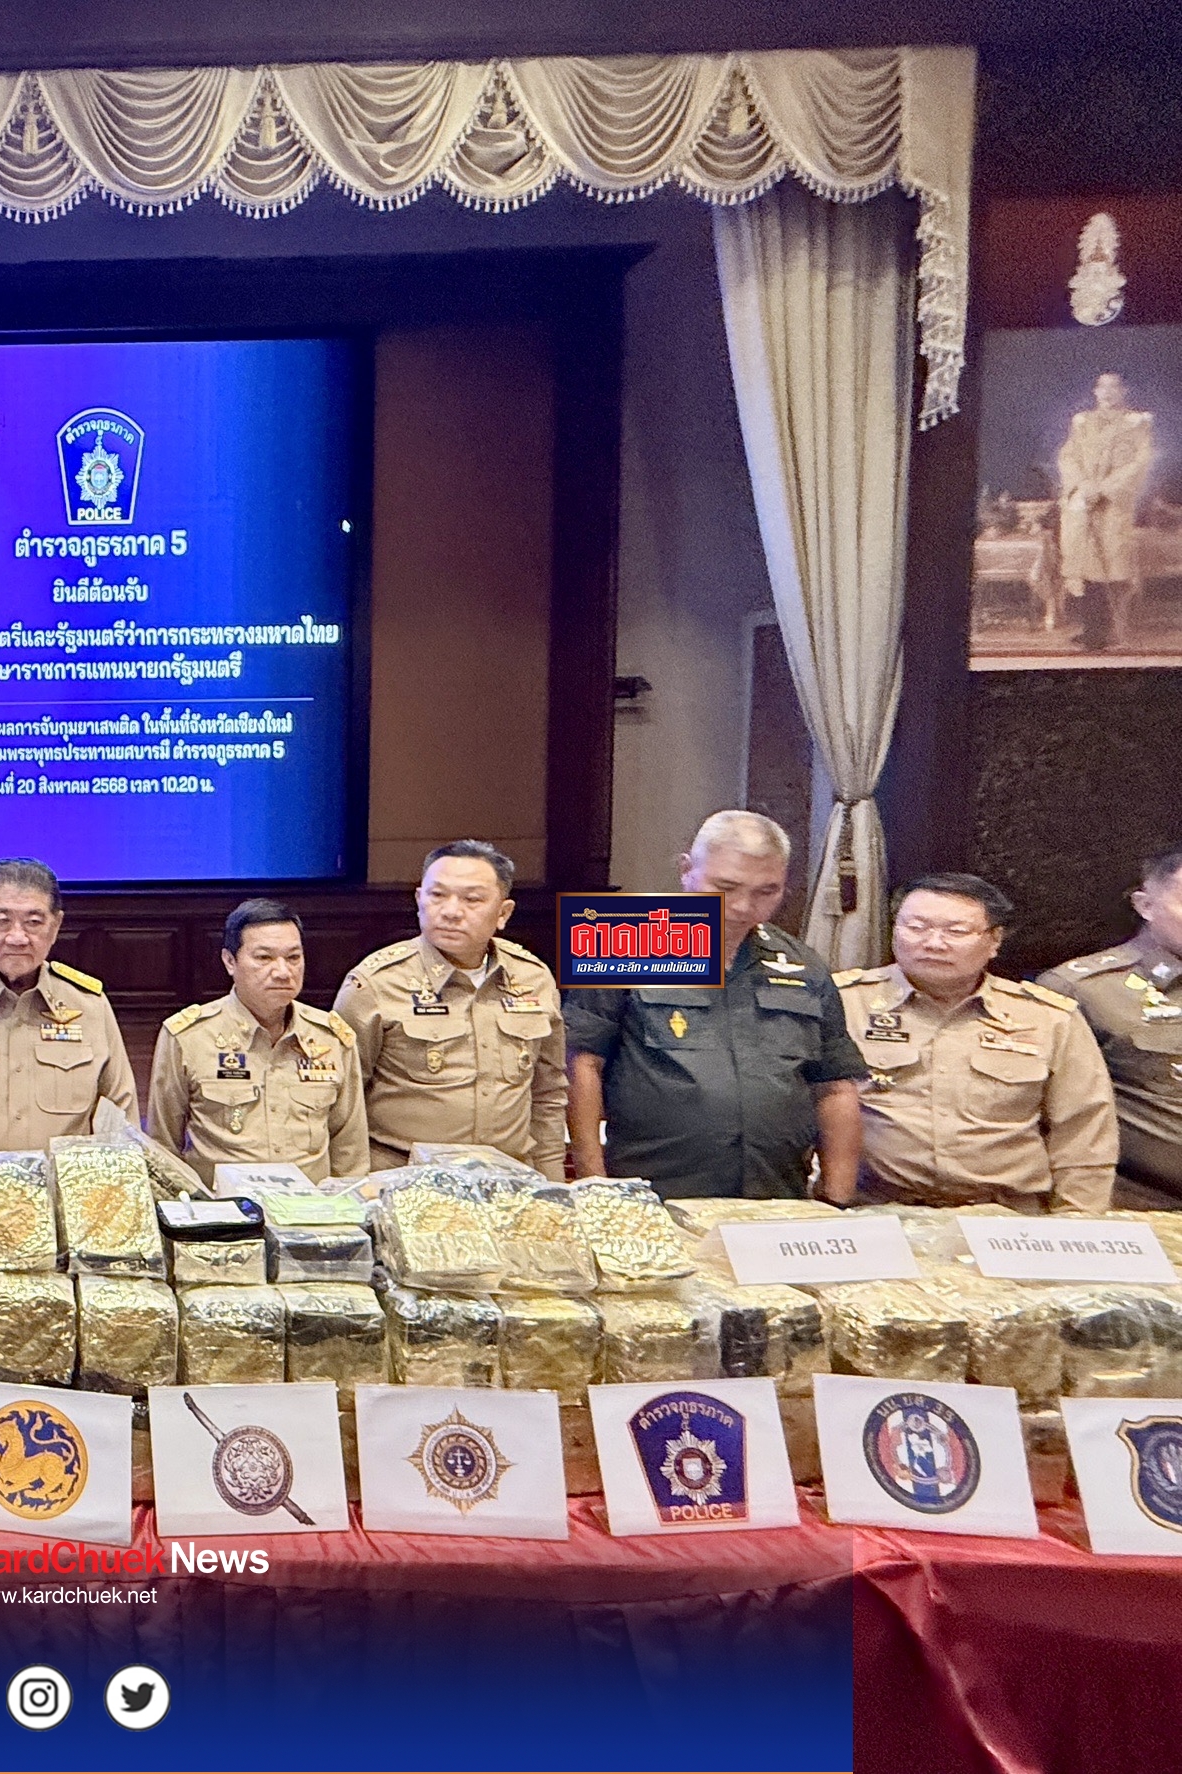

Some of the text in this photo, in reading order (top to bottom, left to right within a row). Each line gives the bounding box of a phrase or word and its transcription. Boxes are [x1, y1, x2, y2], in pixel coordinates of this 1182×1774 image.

[76, 507, 122, 521] POLICE
[15, 528, 188, 566] ตำรวจภูธรภาค 5
[52, 575, 149, 603] ยินดีต้อนรับ
[142, 706, 293, 737] ในพื้นที่จังหวัดเชียงใหม่
[173, 741, 270, 766] ตำรวจภูธรภาค
[272, 742, 285, 758] 5
[17, 779, 35, 794] 20
[38, 777, 89, 795] สิงหาคม
[92, 779, 128, 793] 2568
[130, 780, 160, 793] เวลา
[161, 778, 197, 793] 10.20
[200, 779, 215, 793] น.
[780, 1238, 857, 1257] ตชด.33
[988, 1232, 1143, 1256] กองร้อย ตชด.335
[638, 1400, 735, 1431] ตำรวจภูธรภาค
[670, 1503, 733, 1521] POLICE
